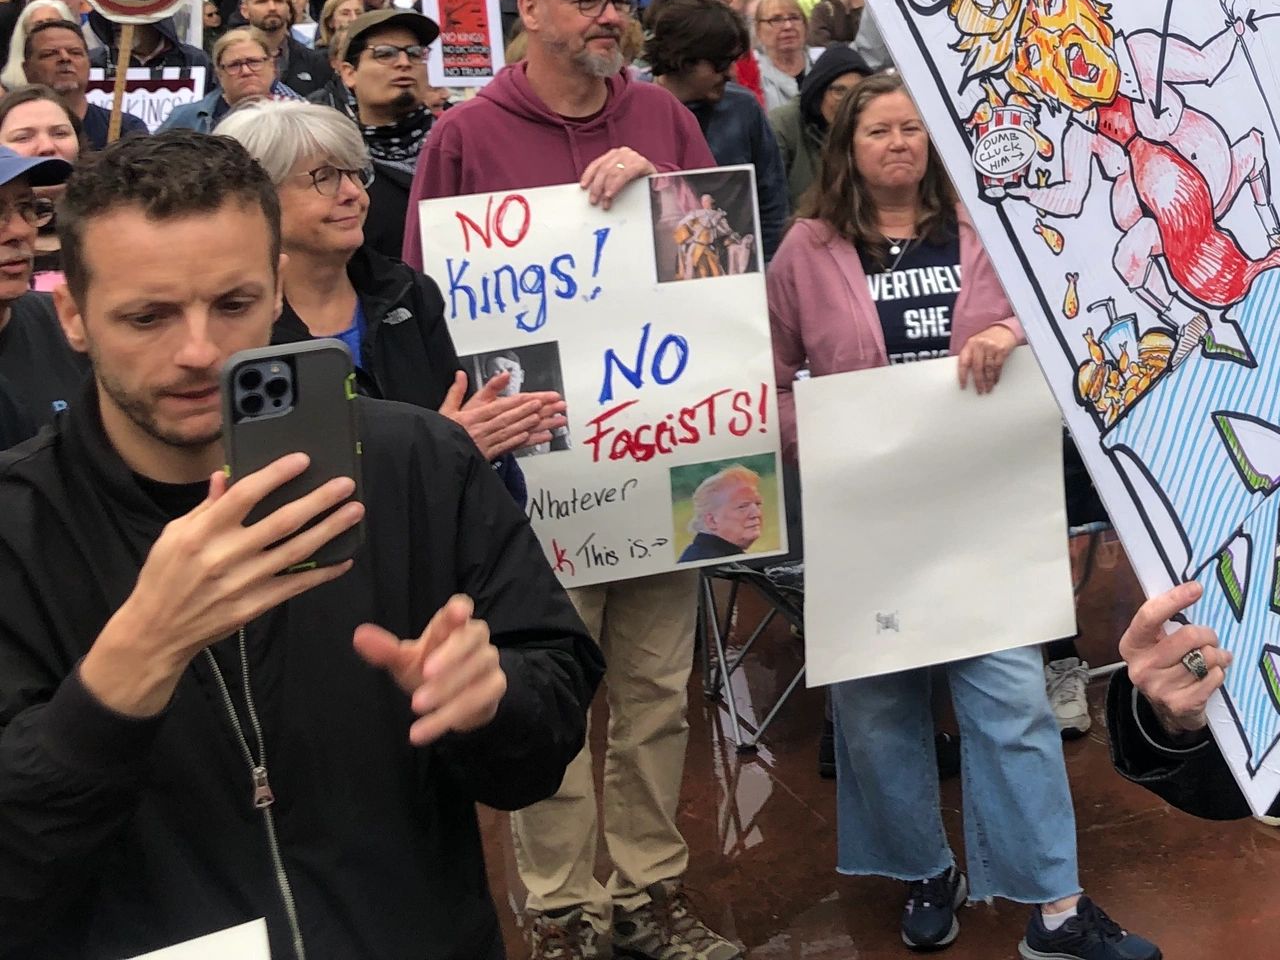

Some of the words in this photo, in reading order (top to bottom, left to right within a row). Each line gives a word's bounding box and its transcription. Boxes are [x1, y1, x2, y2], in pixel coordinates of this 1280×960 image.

[980, 142, 1022, 162] CLUCK
[983, 132, 1020, 151] DUMB
[989, 155, 1010, 171] HIM
[455, 194, 531, 253] NO
[446, 227, 611, 333] Kings!
[903, 306, 952, 339] SHE
[598, 322, 689, 406] NO
[576, 532, 620, 569] This
